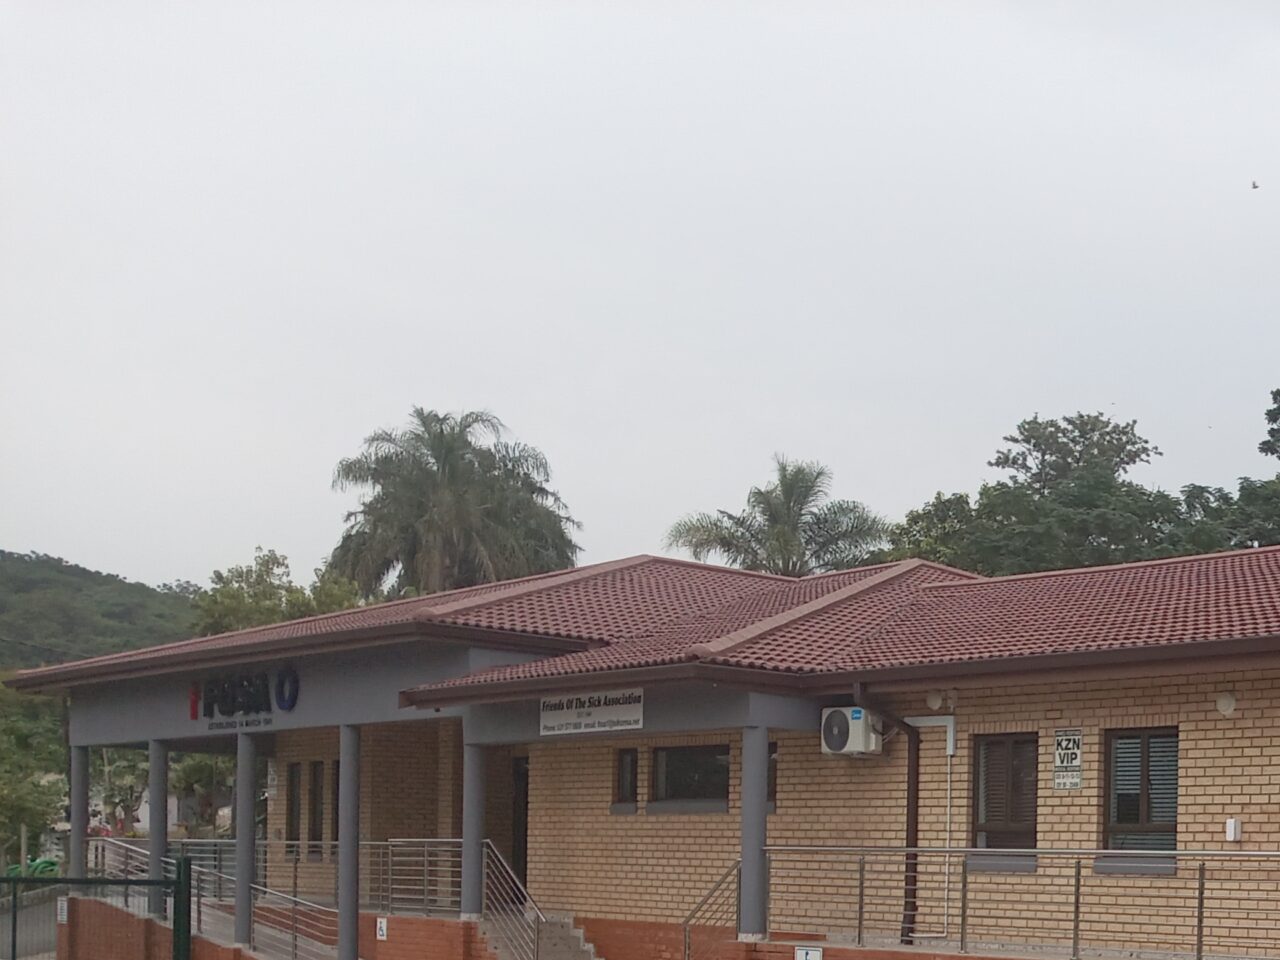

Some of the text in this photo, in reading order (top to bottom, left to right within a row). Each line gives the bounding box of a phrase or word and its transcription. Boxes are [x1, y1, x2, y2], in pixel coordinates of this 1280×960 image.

[542, 692, 642, 713] Friends Of The Sick Association
[1056, 737, 1080, 751] KZN
[1058, 751, 1078, 765] VIP
